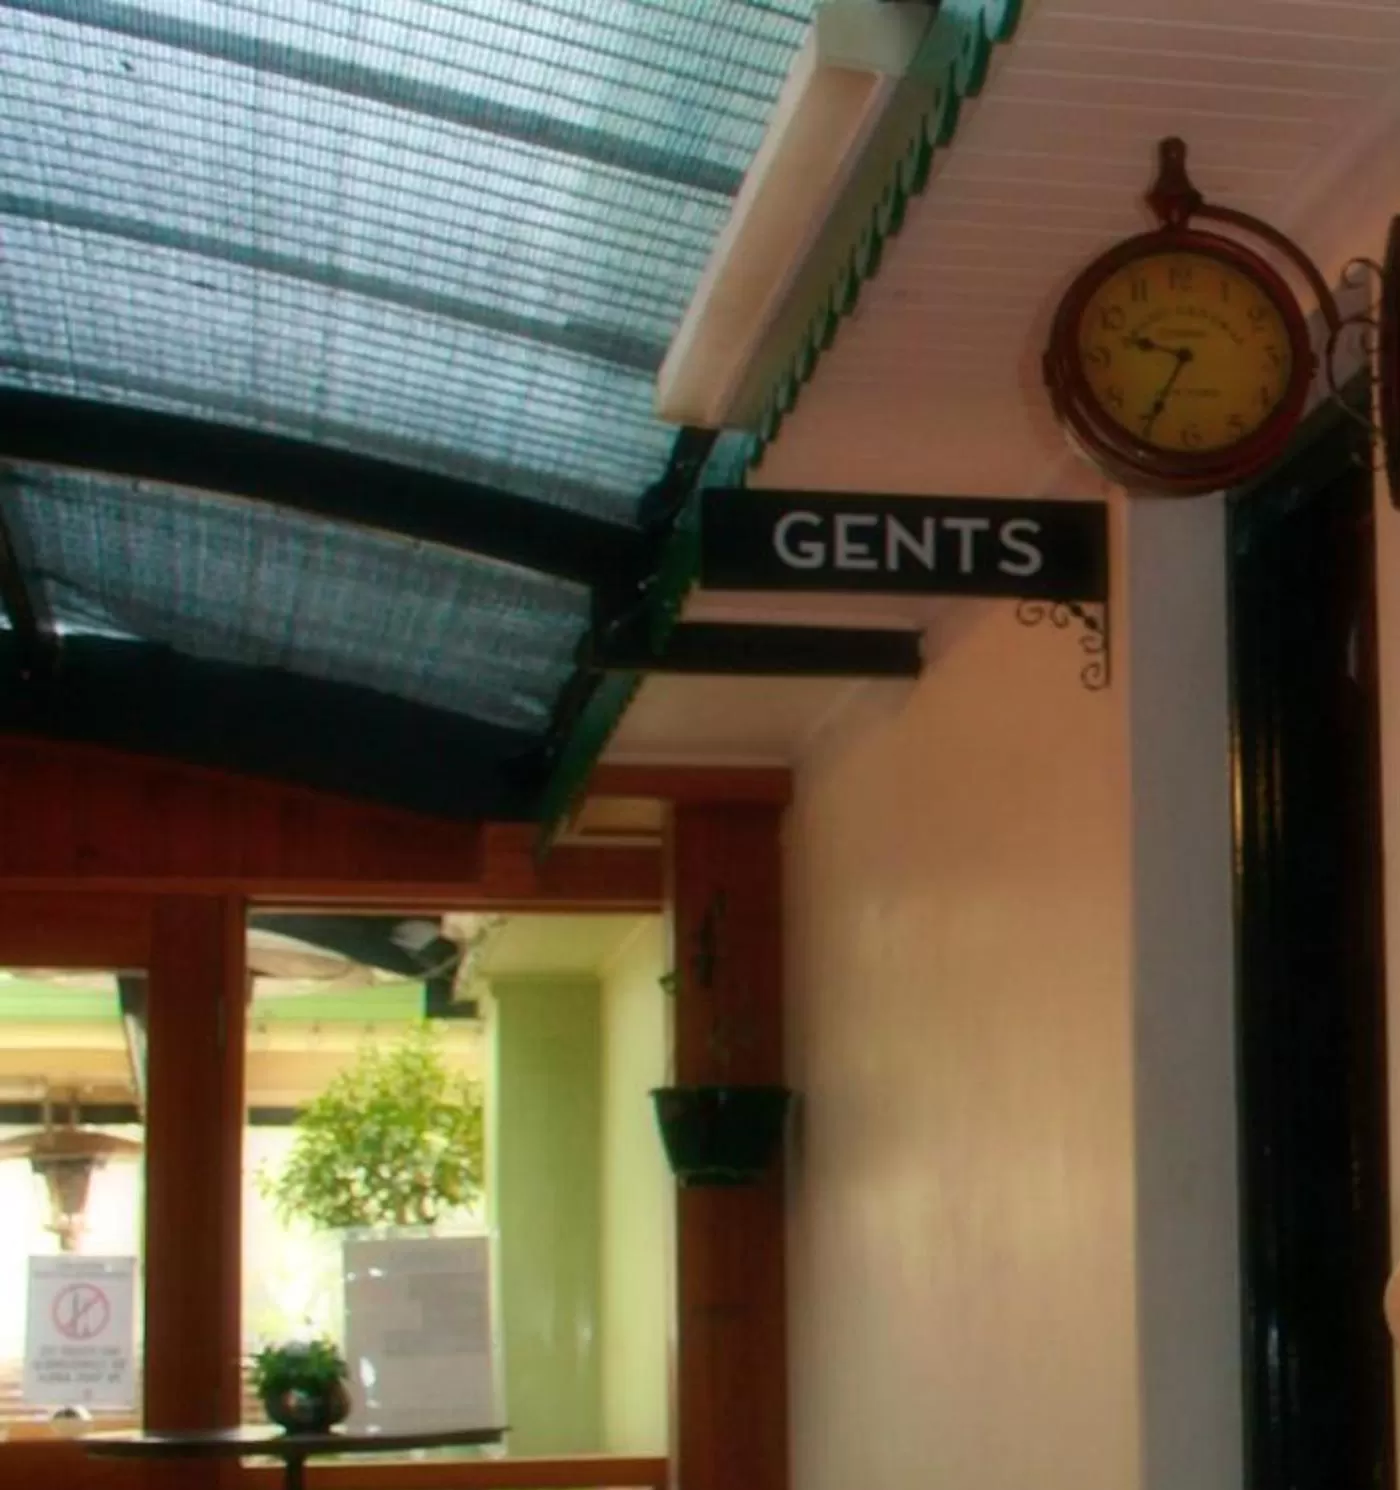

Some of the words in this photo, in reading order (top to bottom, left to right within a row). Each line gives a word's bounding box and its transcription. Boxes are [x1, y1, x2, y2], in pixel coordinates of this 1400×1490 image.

[1131, 278, 1148, 302] 11
[1168, 267, 1193, 292] 12
[1101, 304, 1126, 330] 10
[772, 510, 1043, 577] GENTS
